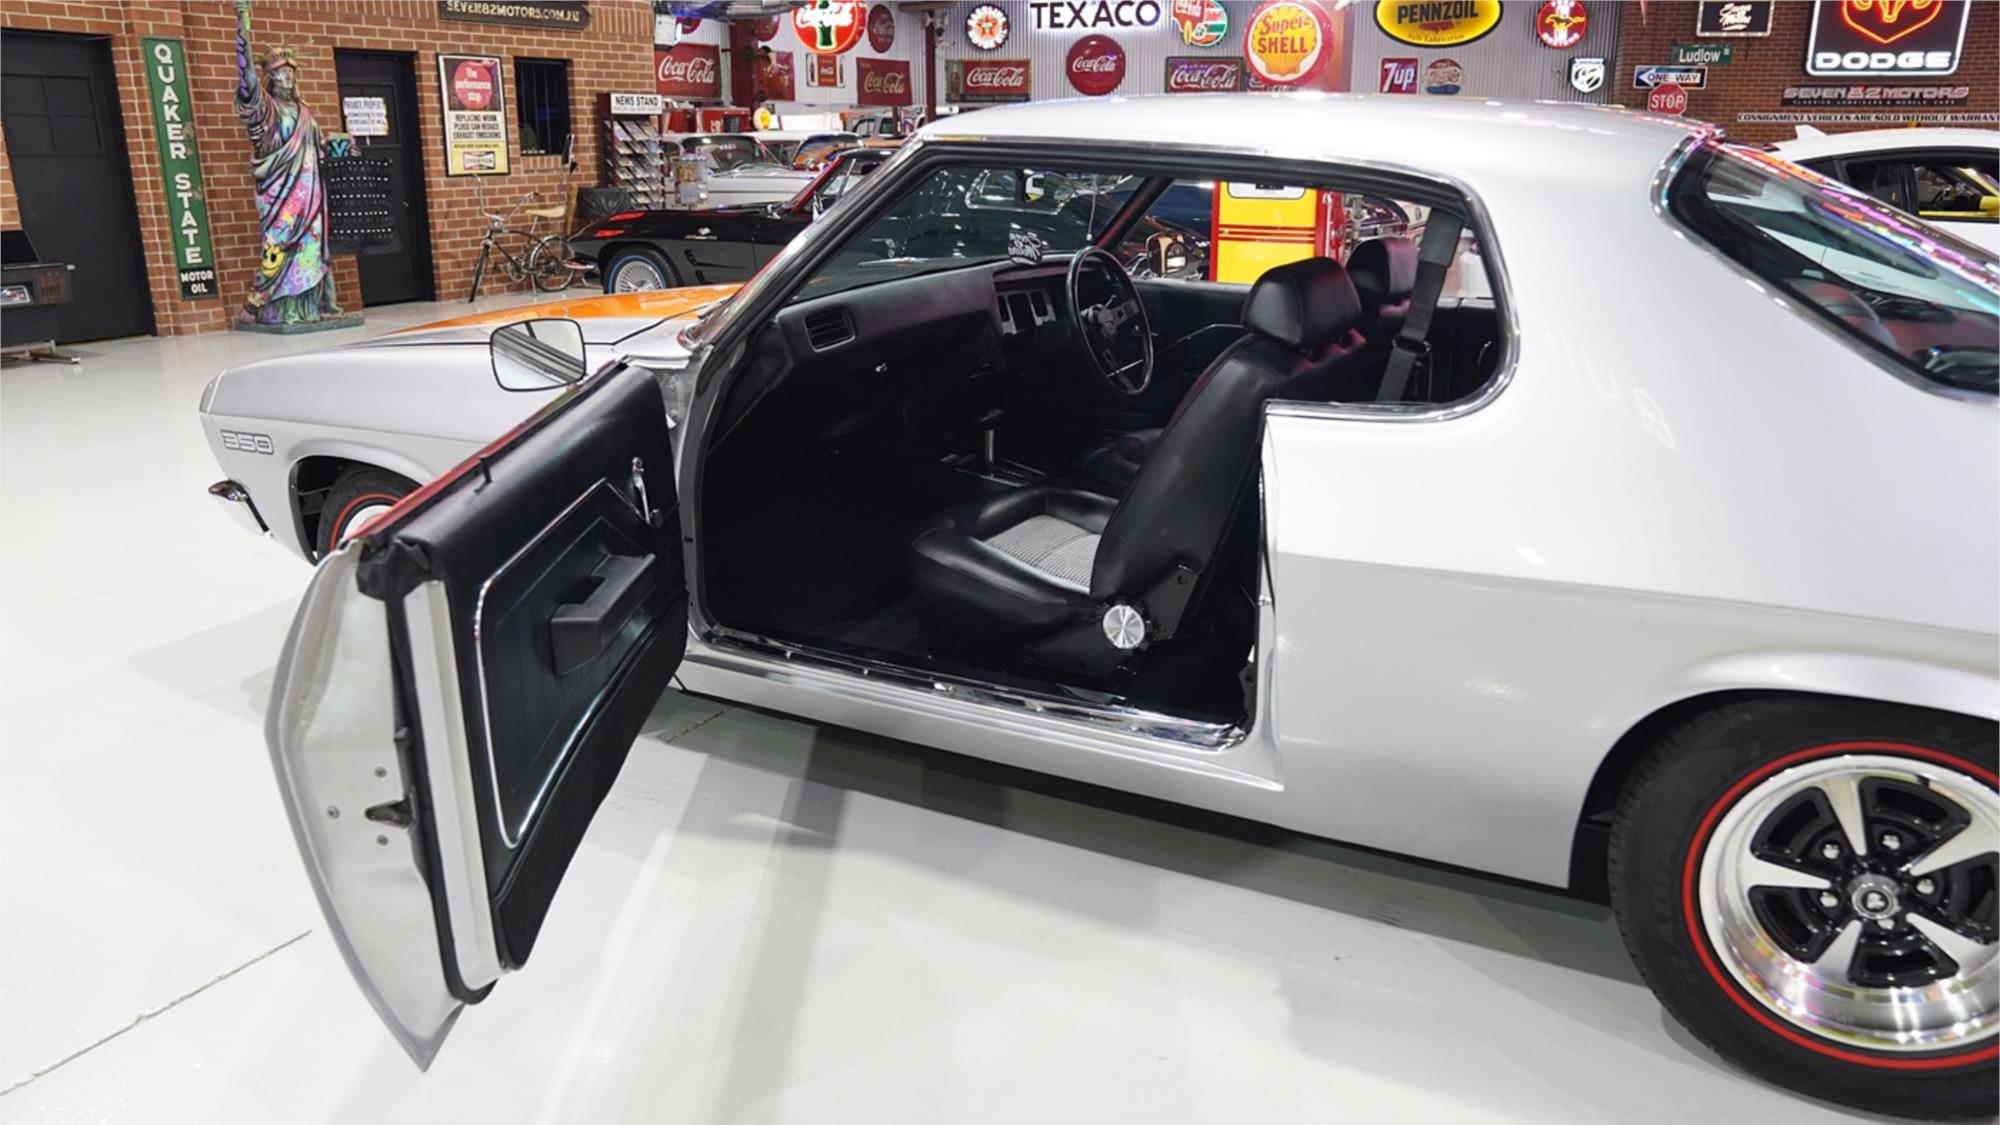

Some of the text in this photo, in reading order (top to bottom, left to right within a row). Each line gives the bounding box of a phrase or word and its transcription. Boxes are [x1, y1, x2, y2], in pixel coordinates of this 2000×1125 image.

[1030, 0, 1160, 29] TEXACO
[1397, 1, 1479, 24] PENNZOIL
[1259, 15, 1310, 35] Super
[1257, 37, 1308, 54] SHELL
[1679, 48, 1720, 62] Ludlow
[1815, 52, 1952, 69] DODGE
[658, 55, 715, 84] Coca-Cola
[1072, 56, 1117, 73] Coca-Cola
[864, 71, 905, 94] Coca-Cola
[966, 66, 1025, 87] Coca-Cola
[1171, 64, 1239, 88] Coca-Cola
[1648, 72, 1698, 82] ONE WAY
[615, 95, 659, 107] NEWS STAND
[1783, 86, 1847, 99] SEVEN
[1882, 86, 1970, 99] MOTORS
[1650, 94, 1685, 109] STOP
[1738, 113, 1804, 121] CONSIGNMENT
[1805, 113, 1852, 121] VEHICLES
[1874, 114, 1900, 122] SOLD
[1901, 114, 1947, 122] WITHOUT
[154, 43, 203, 264] QUAKER STATE
[180, 270, 214, 282] MOTOR
[190, 282, 209, 294] OIL
[220, 429, 275, 455] 350
